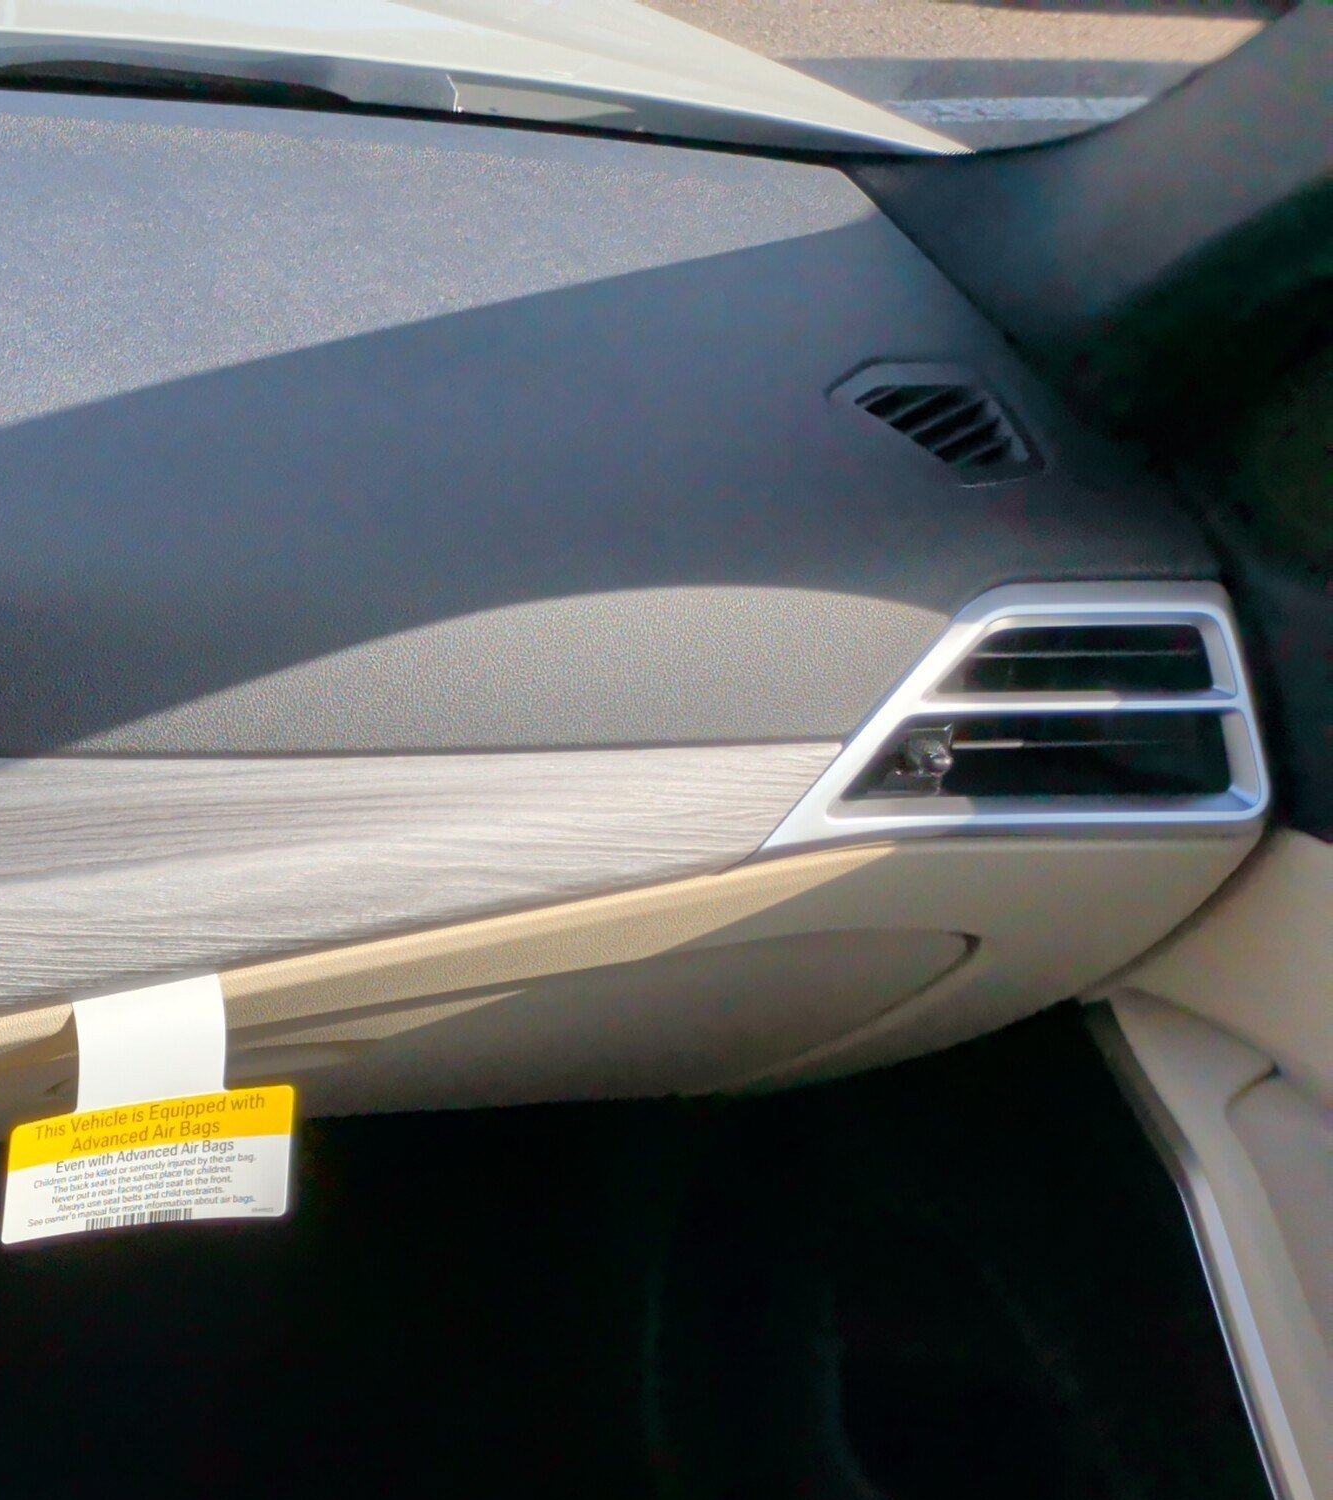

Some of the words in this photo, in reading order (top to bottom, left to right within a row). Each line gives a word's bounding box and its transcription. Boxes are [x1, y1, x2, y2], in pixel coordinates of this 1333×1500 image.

[35, 1123, 66, 1140] This
[70, 1111, 128, 1133] Vehicle
[132, 1108, 144, 1122] is
[149, 1096, 227, 1121] Equipped
[230, 1093, 265, 1111] with
[70, 1125, 149, 1153] Advanced
[152, 1123, 176, 1140] Air
[180, 1120, 221, 1138] Bags
[34, 1176, 67, 1190] Children
[68, 1174, 83, 1182] can
[84, 1171, 94, 1180] be
[119, 1166, 127, 1174] or
[129, 1160, 166, 1173] seriously
[167, 1156, 196, 1168] injured
[198, 1156, 208, 1167] by
[210, 1154, 224, 1163] the
[225, 1153, 236, 1162] air
[237, 1152, 257, 1163] bag.
[56, 1160, 85, 1174] Even
[88, 1153, 113, 1168] with
[117, 1143, 178, 1163] Advanced
[181, 1142, 199, 1155] Air
[202, 1140, 234, 1155] Bags
[52, 1194, 75, 1204] Never
[76, 1191, 90, 1201] put
[144, 1180, 164, 1190] child
[166, 1178, 184, 1188] seat
[185, 1177, 193, 1185] in
[195, 1176, 209, 1185] the
[54, 1185, 69, 1194] The
[70, 1181, 89, 1191] back
[90, 1179, 108, 1188] seat
[118, 1175, 131, 1184] the
[133, 1170, 158, 1181] safest
[159, 1168, 182, 1180] place
[183, 1167, 195, 1177] for
[28, 1217, 44, 1227] See
[45, 1211, 76, 1225] owner's
[77, 1207, 107, 1219] manual
[109, 1204, 120, 1214] for
[122, 1203, 143, 1213] more
[144, 1197, 192, 1210] information
[194, 1195, 219, 1206] about
[220, 1195, 231, 1204] air
[57, 1202, 85, 1213] Always
[87, 1199, 101, 1208] use
[103, 1197, 120, 1206] seat
[122, 1193, 142, 1203] belts
[144, 1189, 159, 1199] and
[161, 1187, 181, 1197] child
